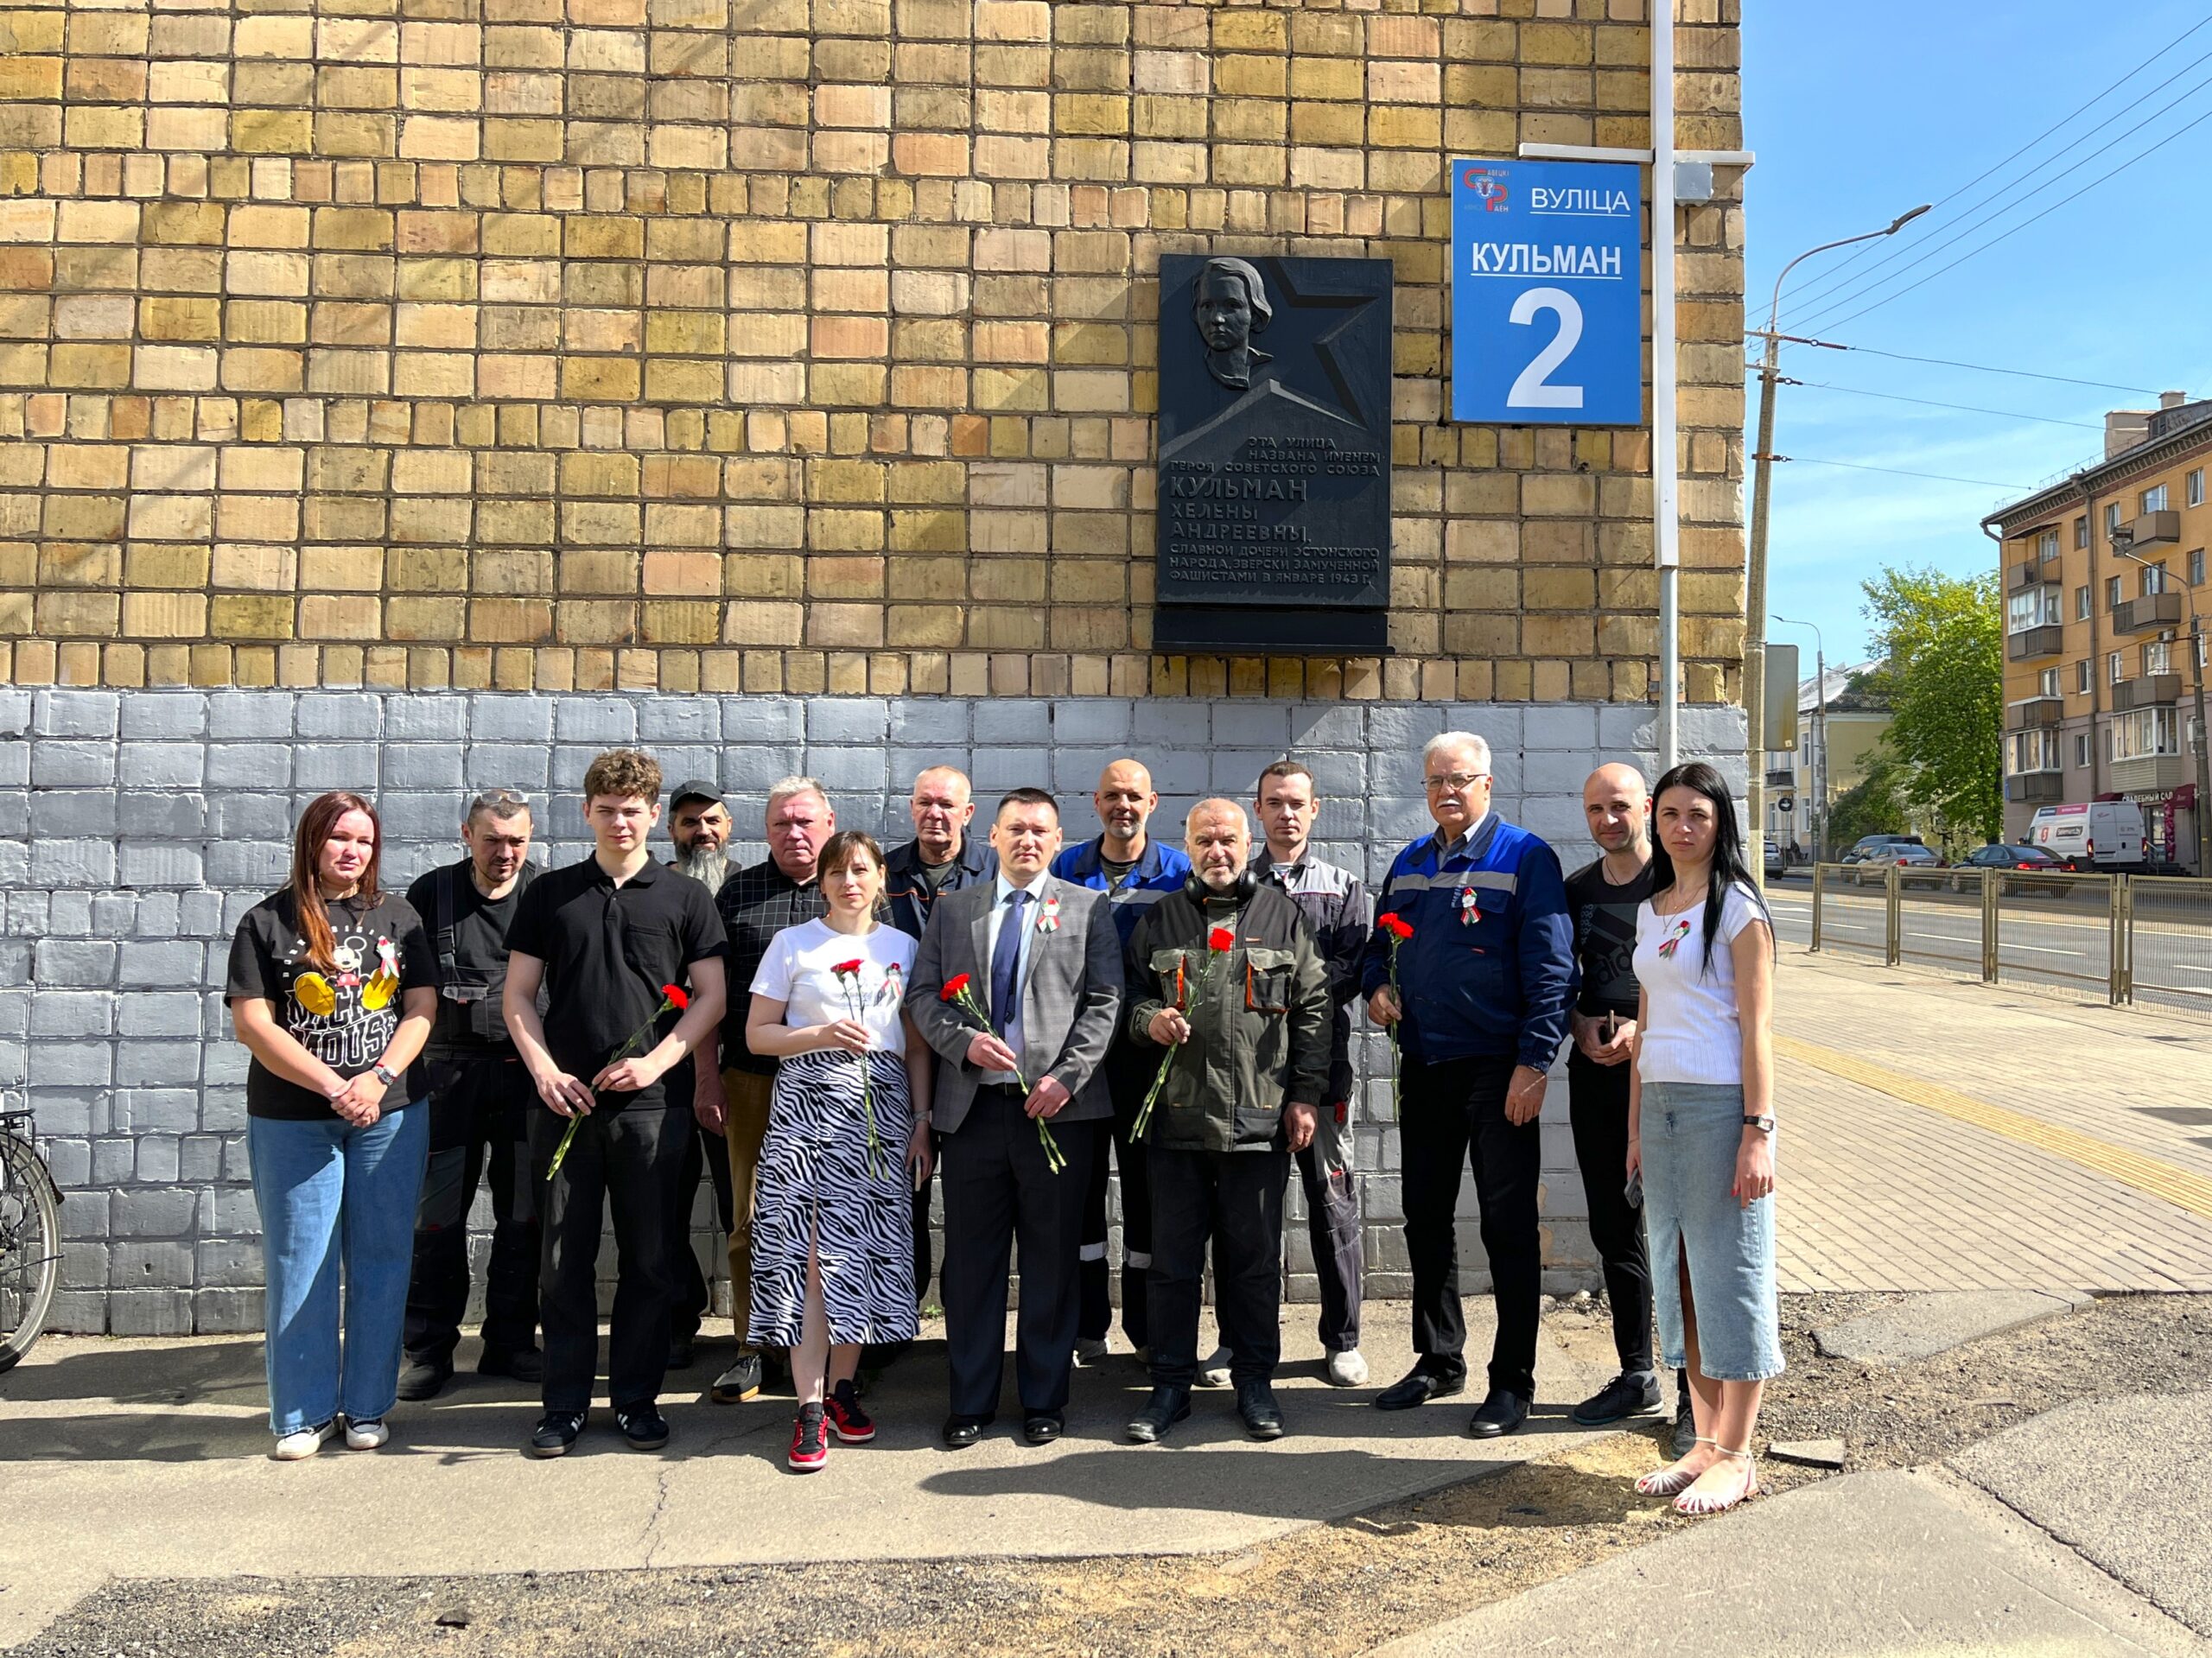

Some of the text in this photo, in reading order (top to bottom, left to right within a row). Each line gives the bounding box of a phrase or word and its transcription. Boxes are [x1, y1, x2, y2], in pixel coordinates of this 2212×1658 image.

[1531, 188, 1630, 213] ВУЛІЦА
[1471, 243, 1621, 275] КУЛЬМАН
[1506, 287, 1584, 409] 2
[1249, 435, 1337, 450] ЭТА УЛИЦА
[1249, 449, 1381, 464] НАЗВАНА ИМЕНЕМ
[1170, 460, 1381, 477] ГЕРОЯ СОВЕТСКОГО СОЮЗА
[1170, 476, 1307, 502] КУЛЬМАН
[1170, 502, 1258, 521] ХЕЛЕНЫ
[1238, 545, 1288, 557] ДОЧЕРИ
[1293, 546, 1380, 558] ЭСТОНСКОГО
[1232, 558, 1289, 570] ЗВЕРСКИ
[1168, 570, 1257, 582] ФАШИСТАМИ
[1262, 571, 1271, 582] В
[1274, 572, 1325, 584] ЯНВАРЕ
[1331, 573, 1358, 584] 1943
